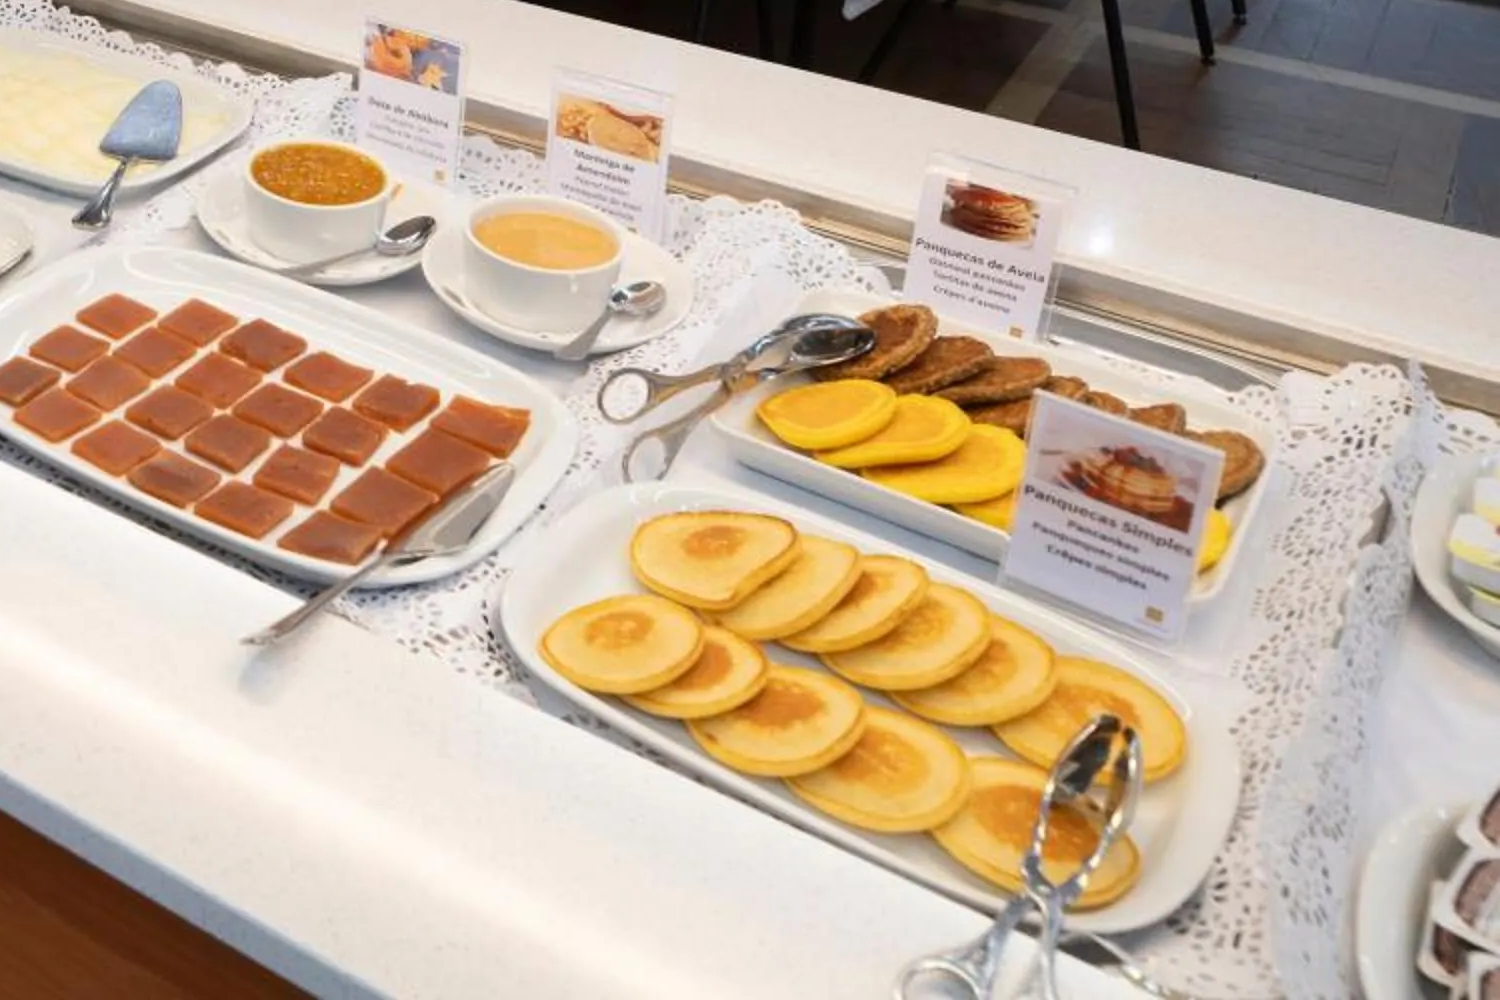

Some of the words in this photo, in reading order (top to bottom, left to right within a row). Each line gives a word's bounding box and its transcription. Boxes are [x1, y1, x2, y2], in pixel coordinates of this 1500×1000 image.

[915, 237, 985, 266] Panquecas
[987, 258, 1003, 271] de
[1006, 265, 1046, 284] Aveia
[1024, 484, 1118, 529] Panquecas
[1120, 521, 1195, 558] Simples
[1094, 560, 1148, 591] simples
[1116, 553, 1171, 582] simples
